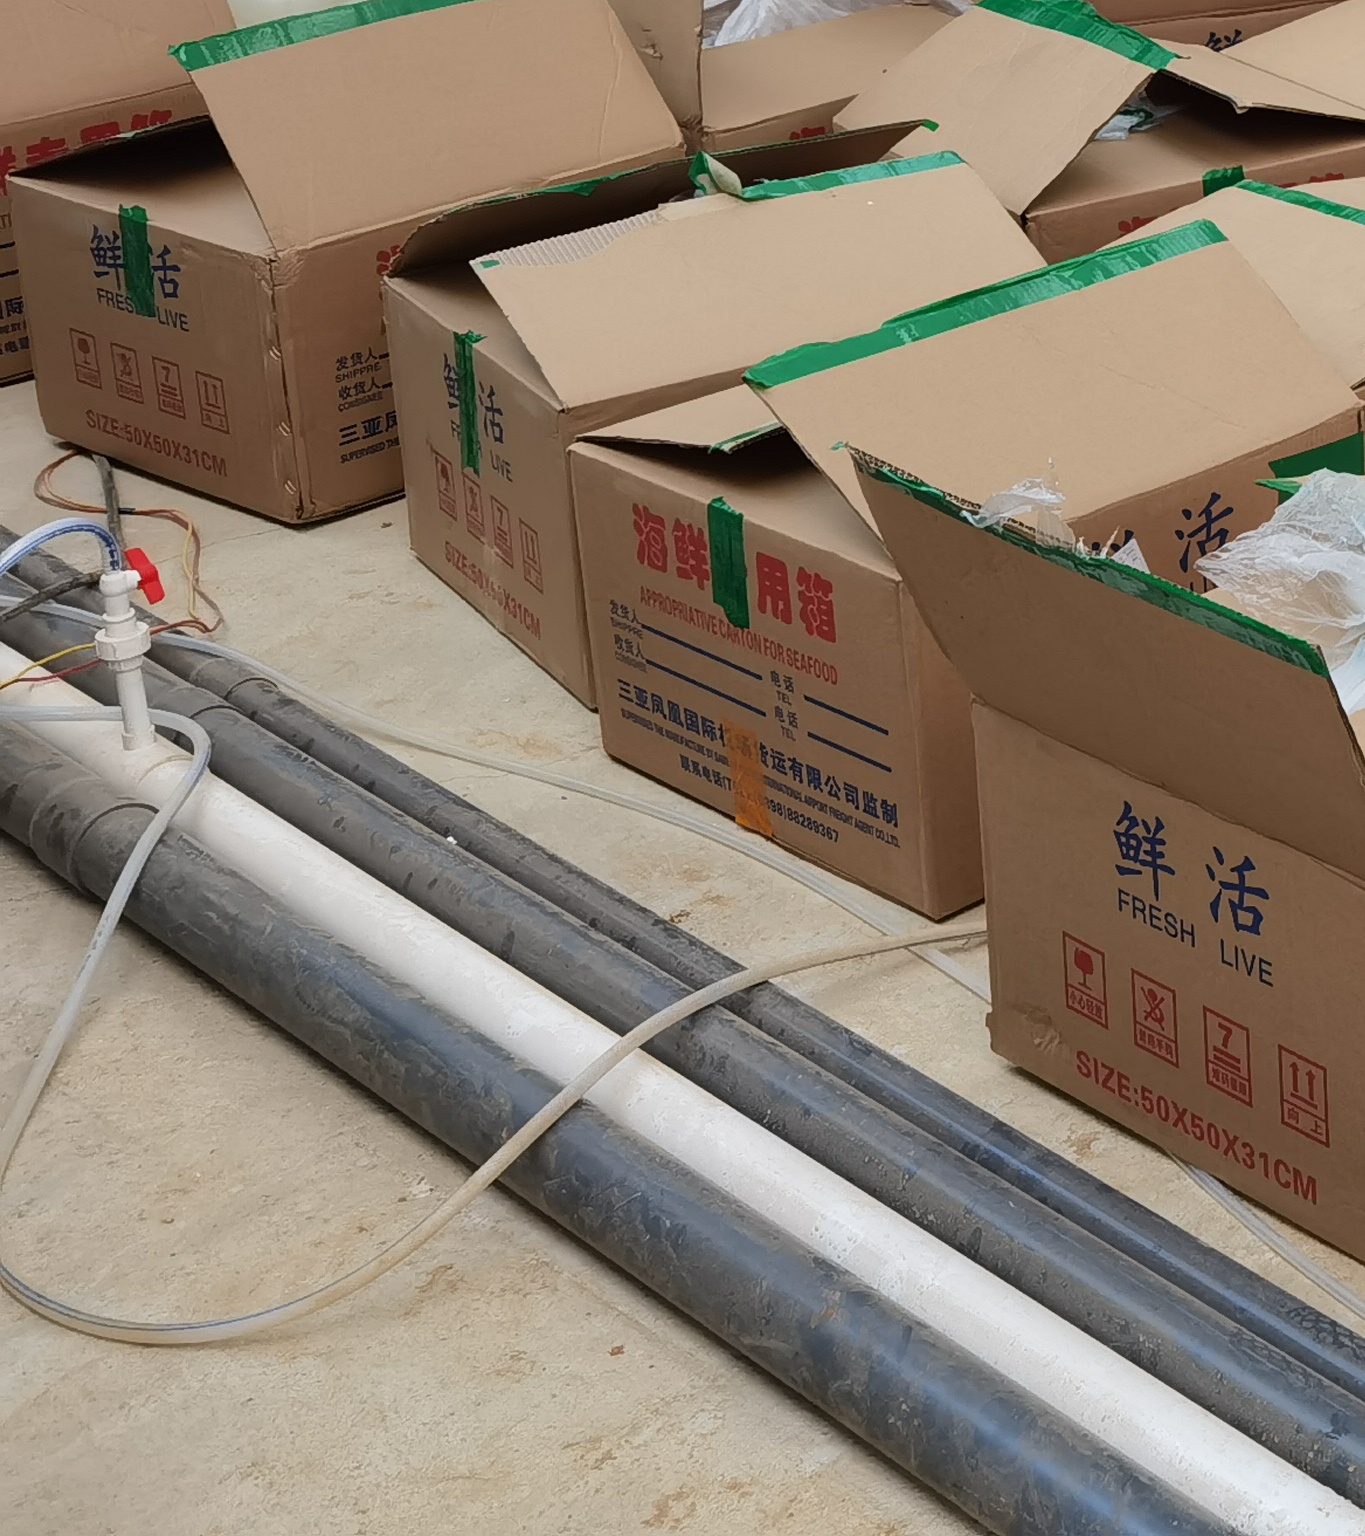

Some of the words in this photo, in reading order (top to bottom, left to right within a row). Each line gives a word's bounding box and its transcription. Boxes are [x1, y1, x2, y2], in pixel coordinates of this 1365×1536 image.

[156, 305, 190, 332] LIVE
[632, 503, 838, 644] 海鲜用箱
[640, 585, 718, 637] APPROPRIATIVE
[763, 636, 786, 665] FOR
[786, 644, 838, 686] SEAFOOD
[770, 670, 795, 695] 电话
[774, 705, 799, 730] 电话
[1112, 800, 1270, 937] 鲜活
[1117, 887, 1197, 949] FRESH
[1218, 937, 1274, 988] LIVE
[1074, 1048, 1320, 1207] SIZE:50X50X31CM
